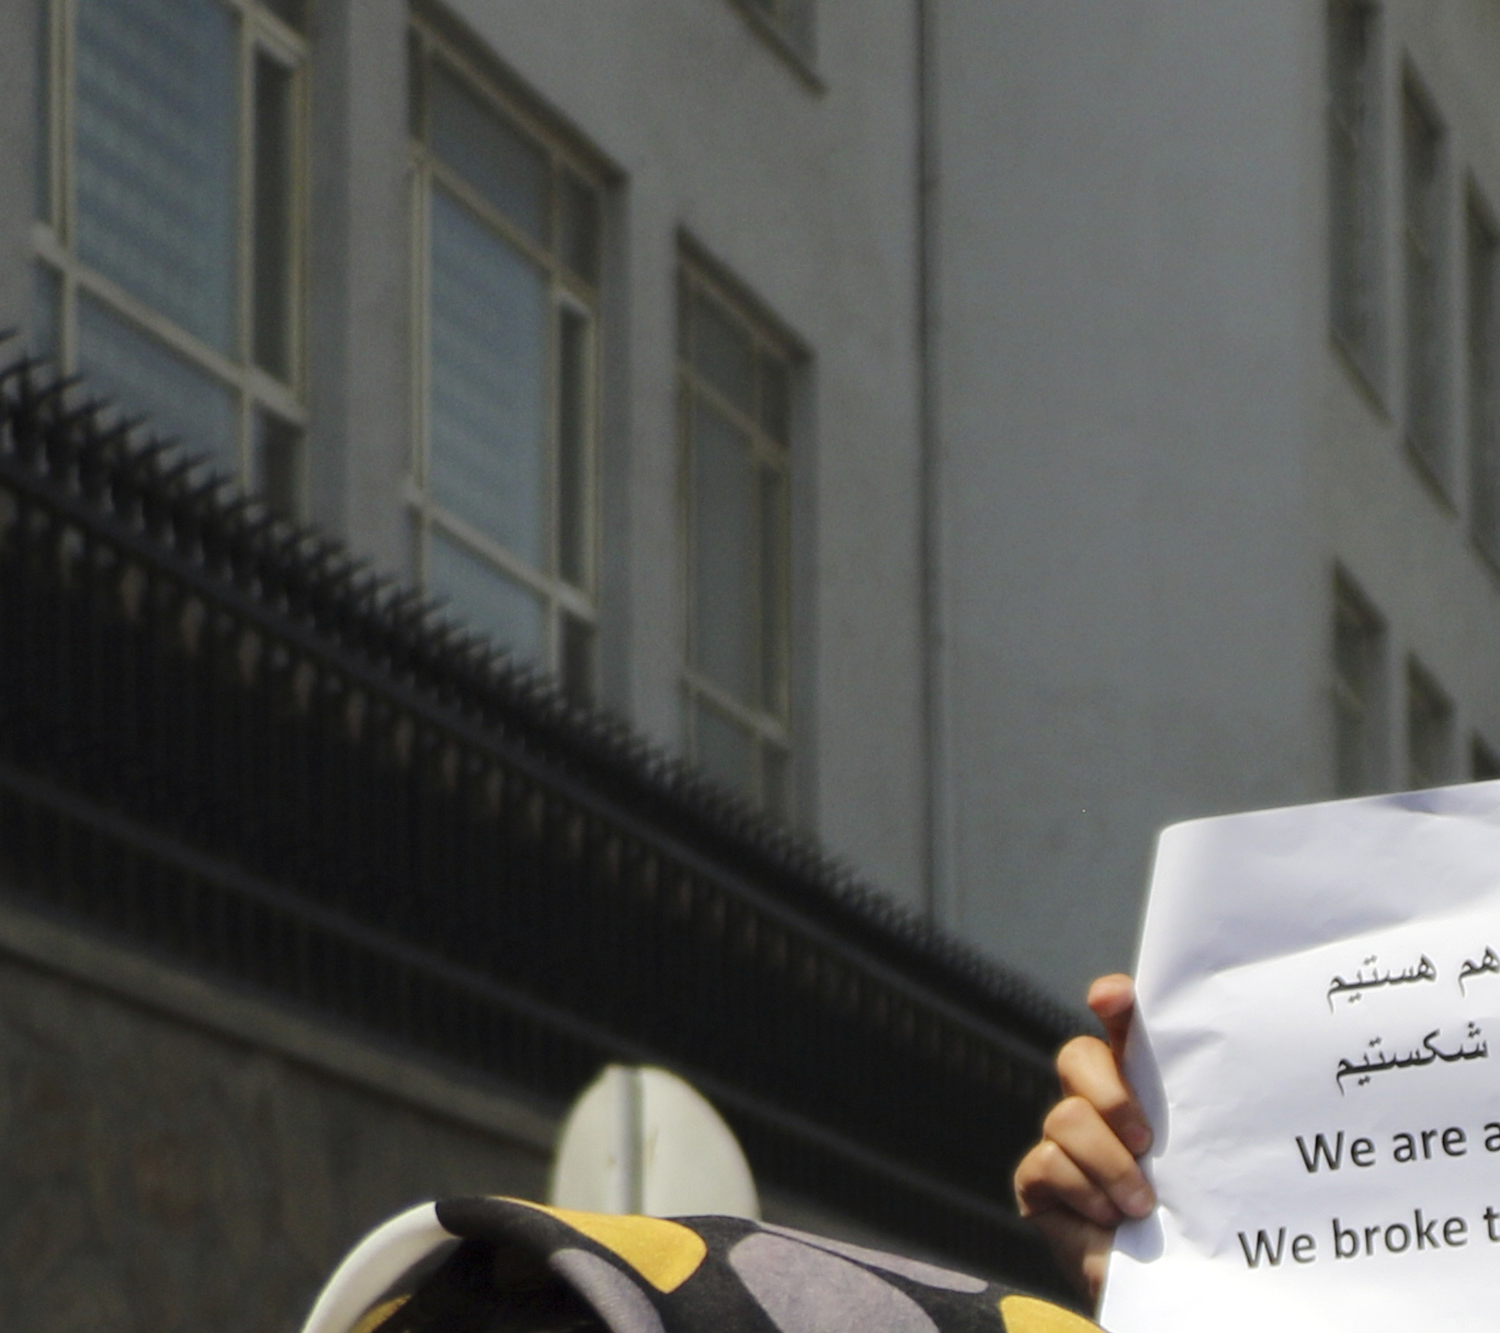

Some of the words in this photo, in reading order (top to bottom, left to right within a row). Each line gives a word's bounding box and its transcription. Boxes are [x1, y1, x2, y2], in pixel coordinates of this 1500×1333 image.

[1327, 955, 1436, 1011] هستیم
[1458, 947, 1500, 994] هم
[1336, 1023, 1487, 1094] شکستیم
[1295, 1131, 1375, 1173] We
[1393, 1127, 1466, 1163] are
[1237, 1227, 1315, 1267] We
[1332, 1209, 1467, 1258] broke
